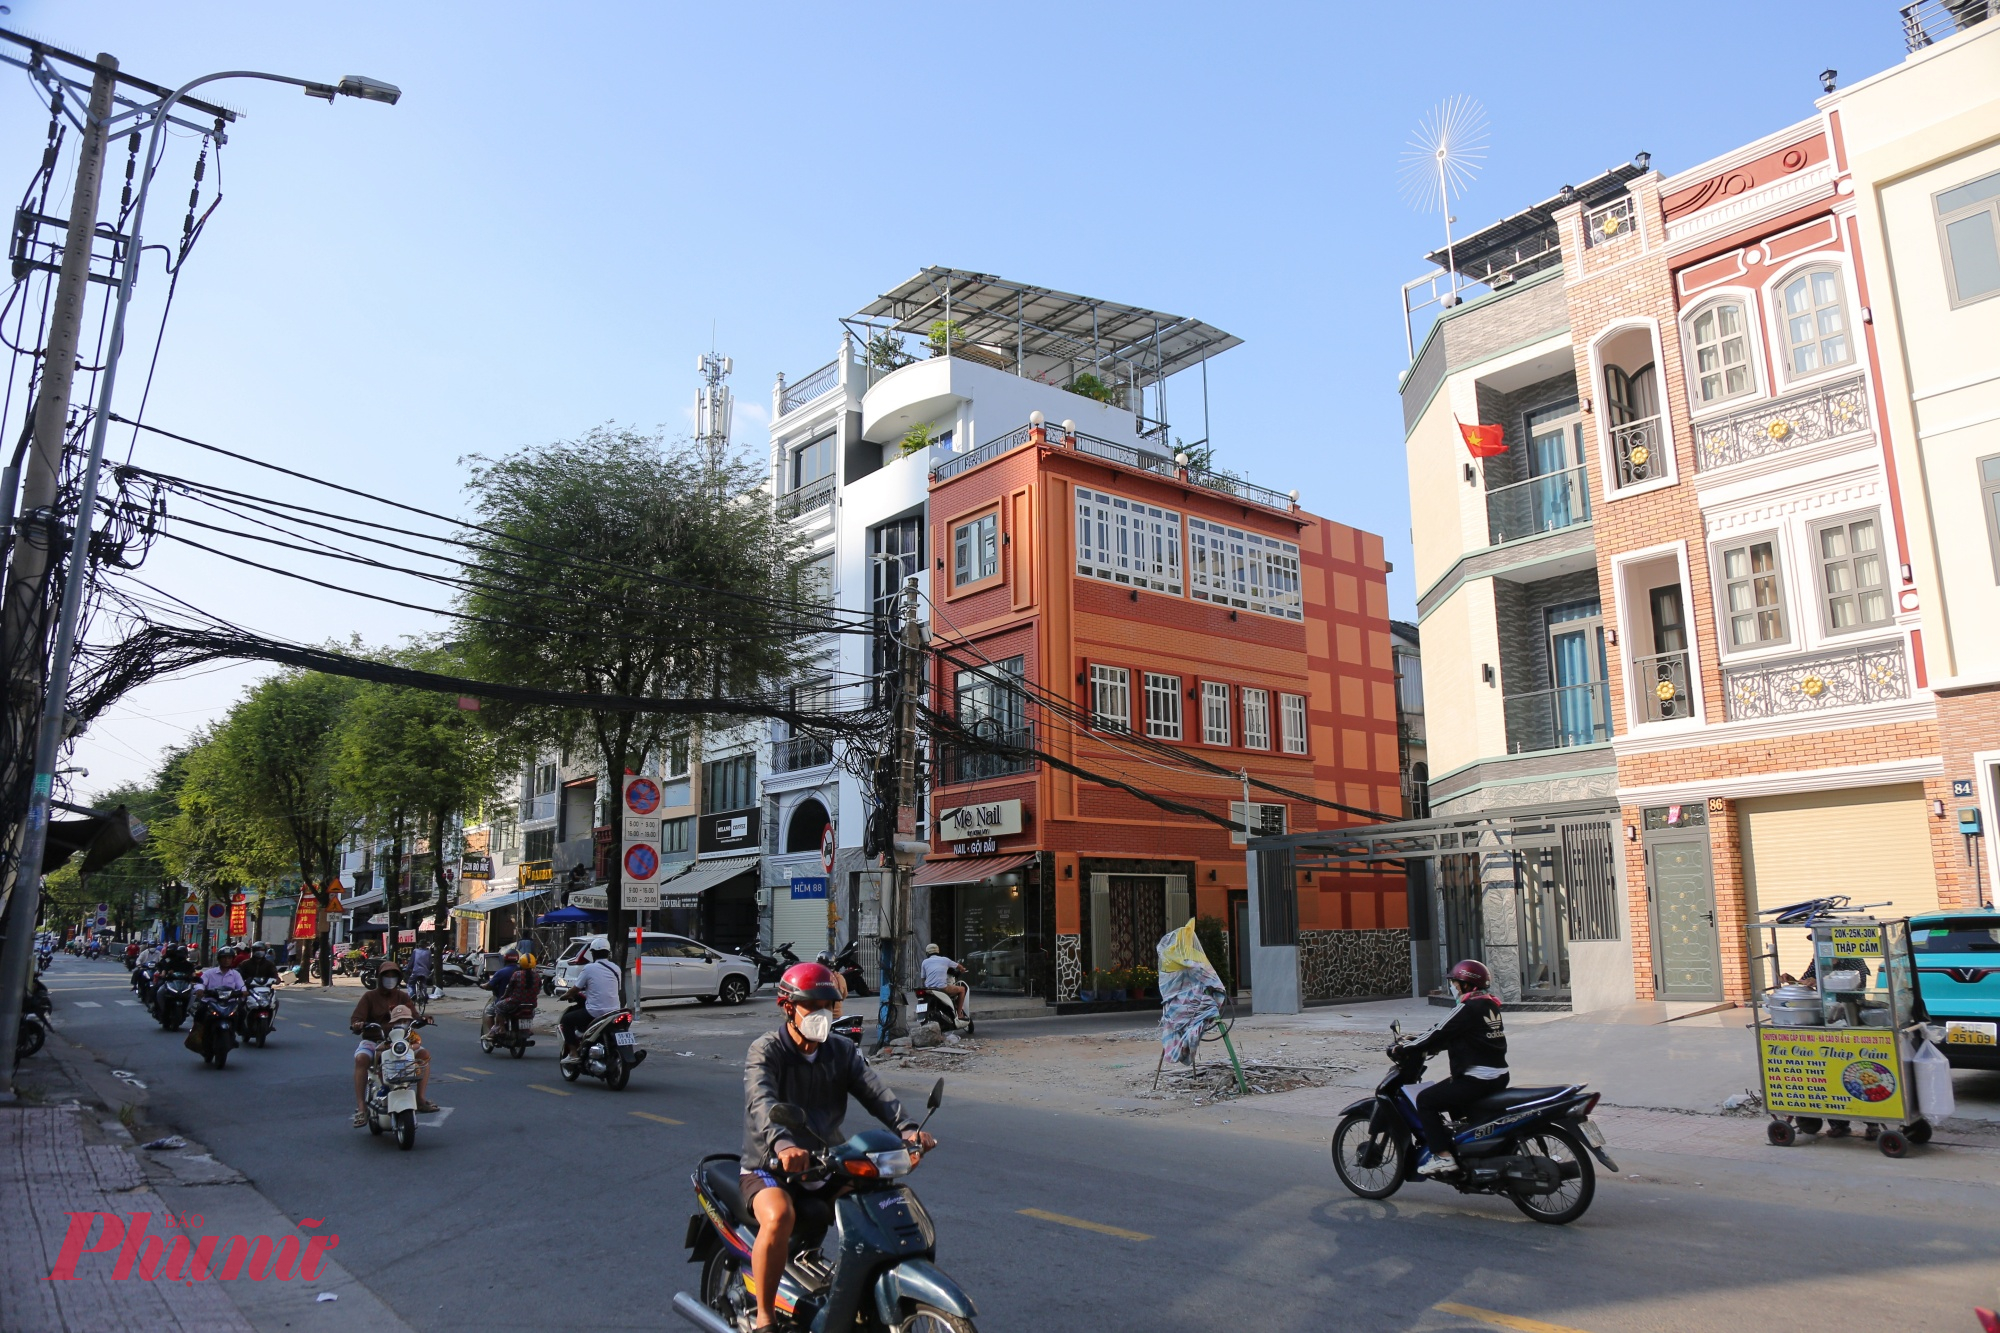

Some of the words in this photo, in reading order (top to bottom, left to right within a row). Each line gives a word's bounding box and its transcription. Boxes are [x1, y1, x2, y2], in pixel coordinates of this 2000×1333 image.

[1955, 782, 1971, 795] 84
[1710, 798, 1723, 811] 86
[954, 809, 973, 829] Mê
[976, 805, 1001, 827] Nail
[953, 843, 966, 855] NAIL
[970, 839, 982, 856] GỘI
[983, 837, 996, 853] ĐẦU
[812, 883, 822, 892] 88
[1834, 928, 1877, 938] 20K-25K-30K
[1835, 940, 1857, 955] THẬP
[1859, 938, 1879, 953] CẨM
[1952, 1034, 1991, 1045] 351.09
[1819, 1045, 1855, 1061] Thập
[705, 1200, 725, 1229] Wave
